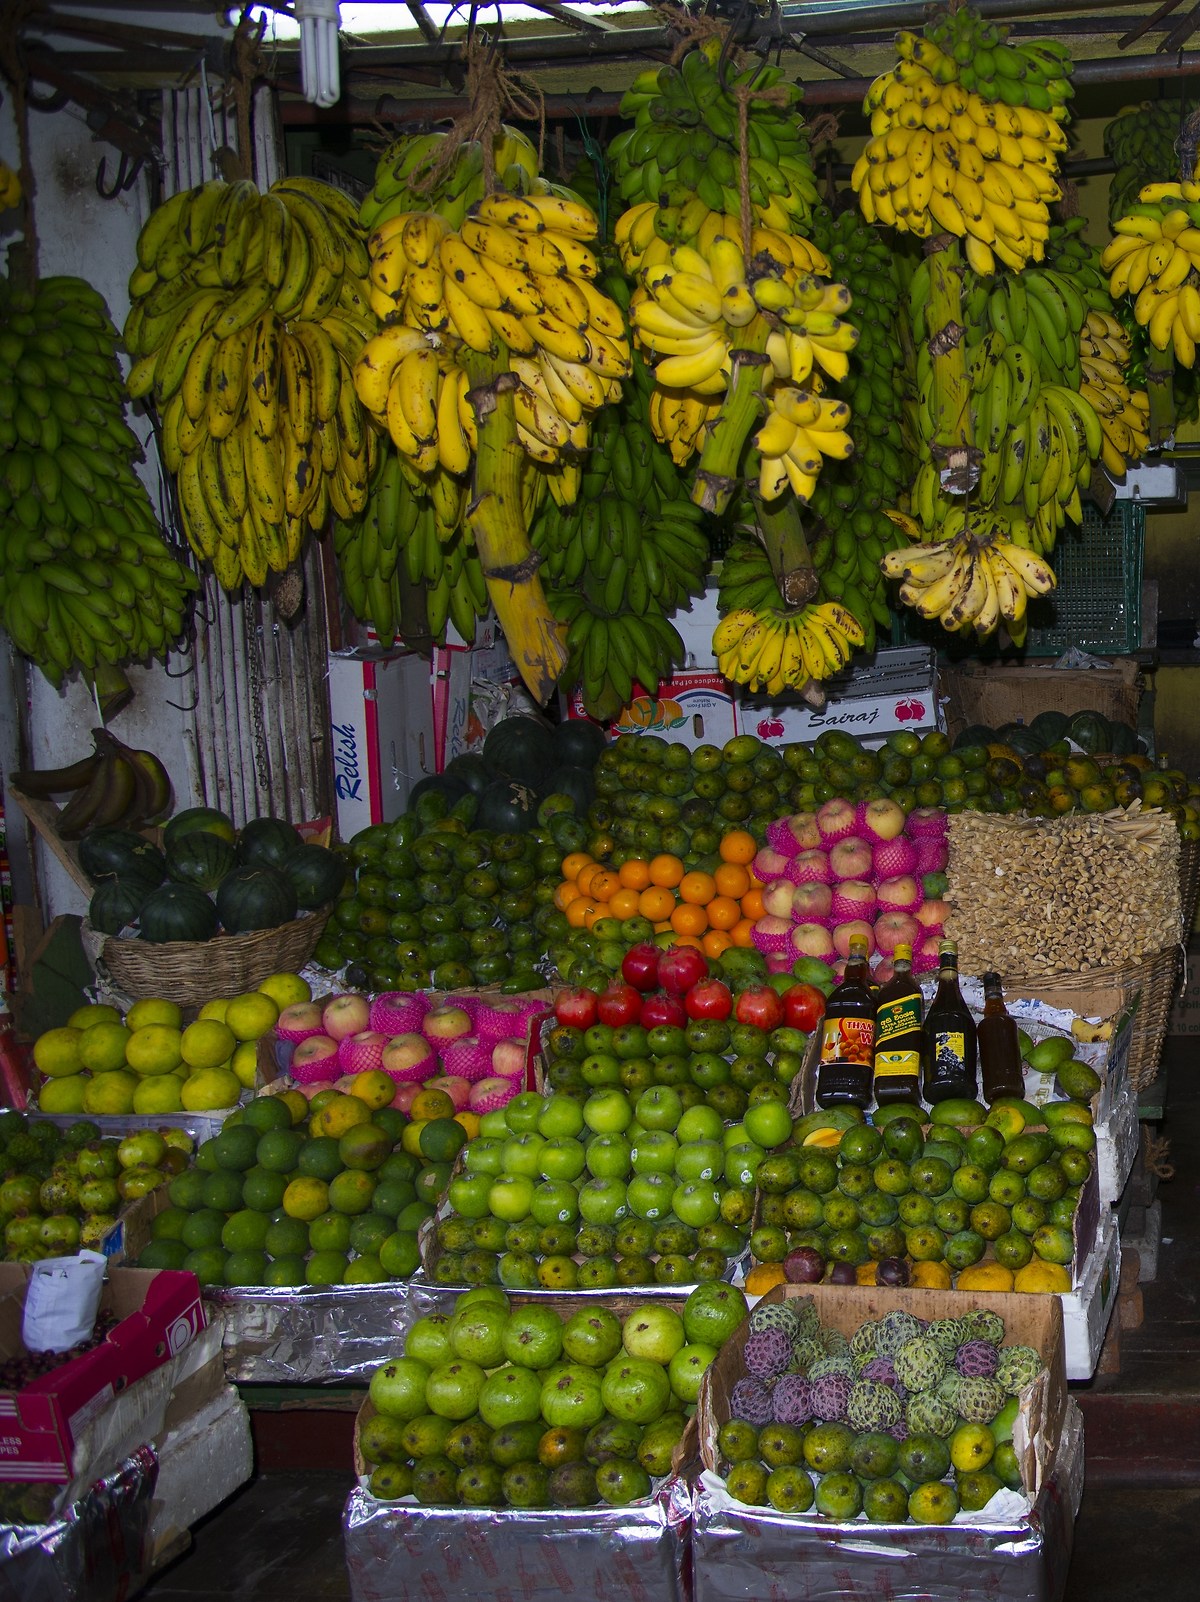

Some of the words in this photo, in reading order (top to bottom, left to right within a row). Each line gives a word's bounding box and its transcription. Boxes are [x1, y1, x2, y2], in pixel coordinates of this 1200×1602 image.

[808, 707, 879, 728] Sairaj
[332, 723, 363, 802] Relish
[1177, 1024, 1186, 1032] 10
[0, 1446, 19, 1455] PES
